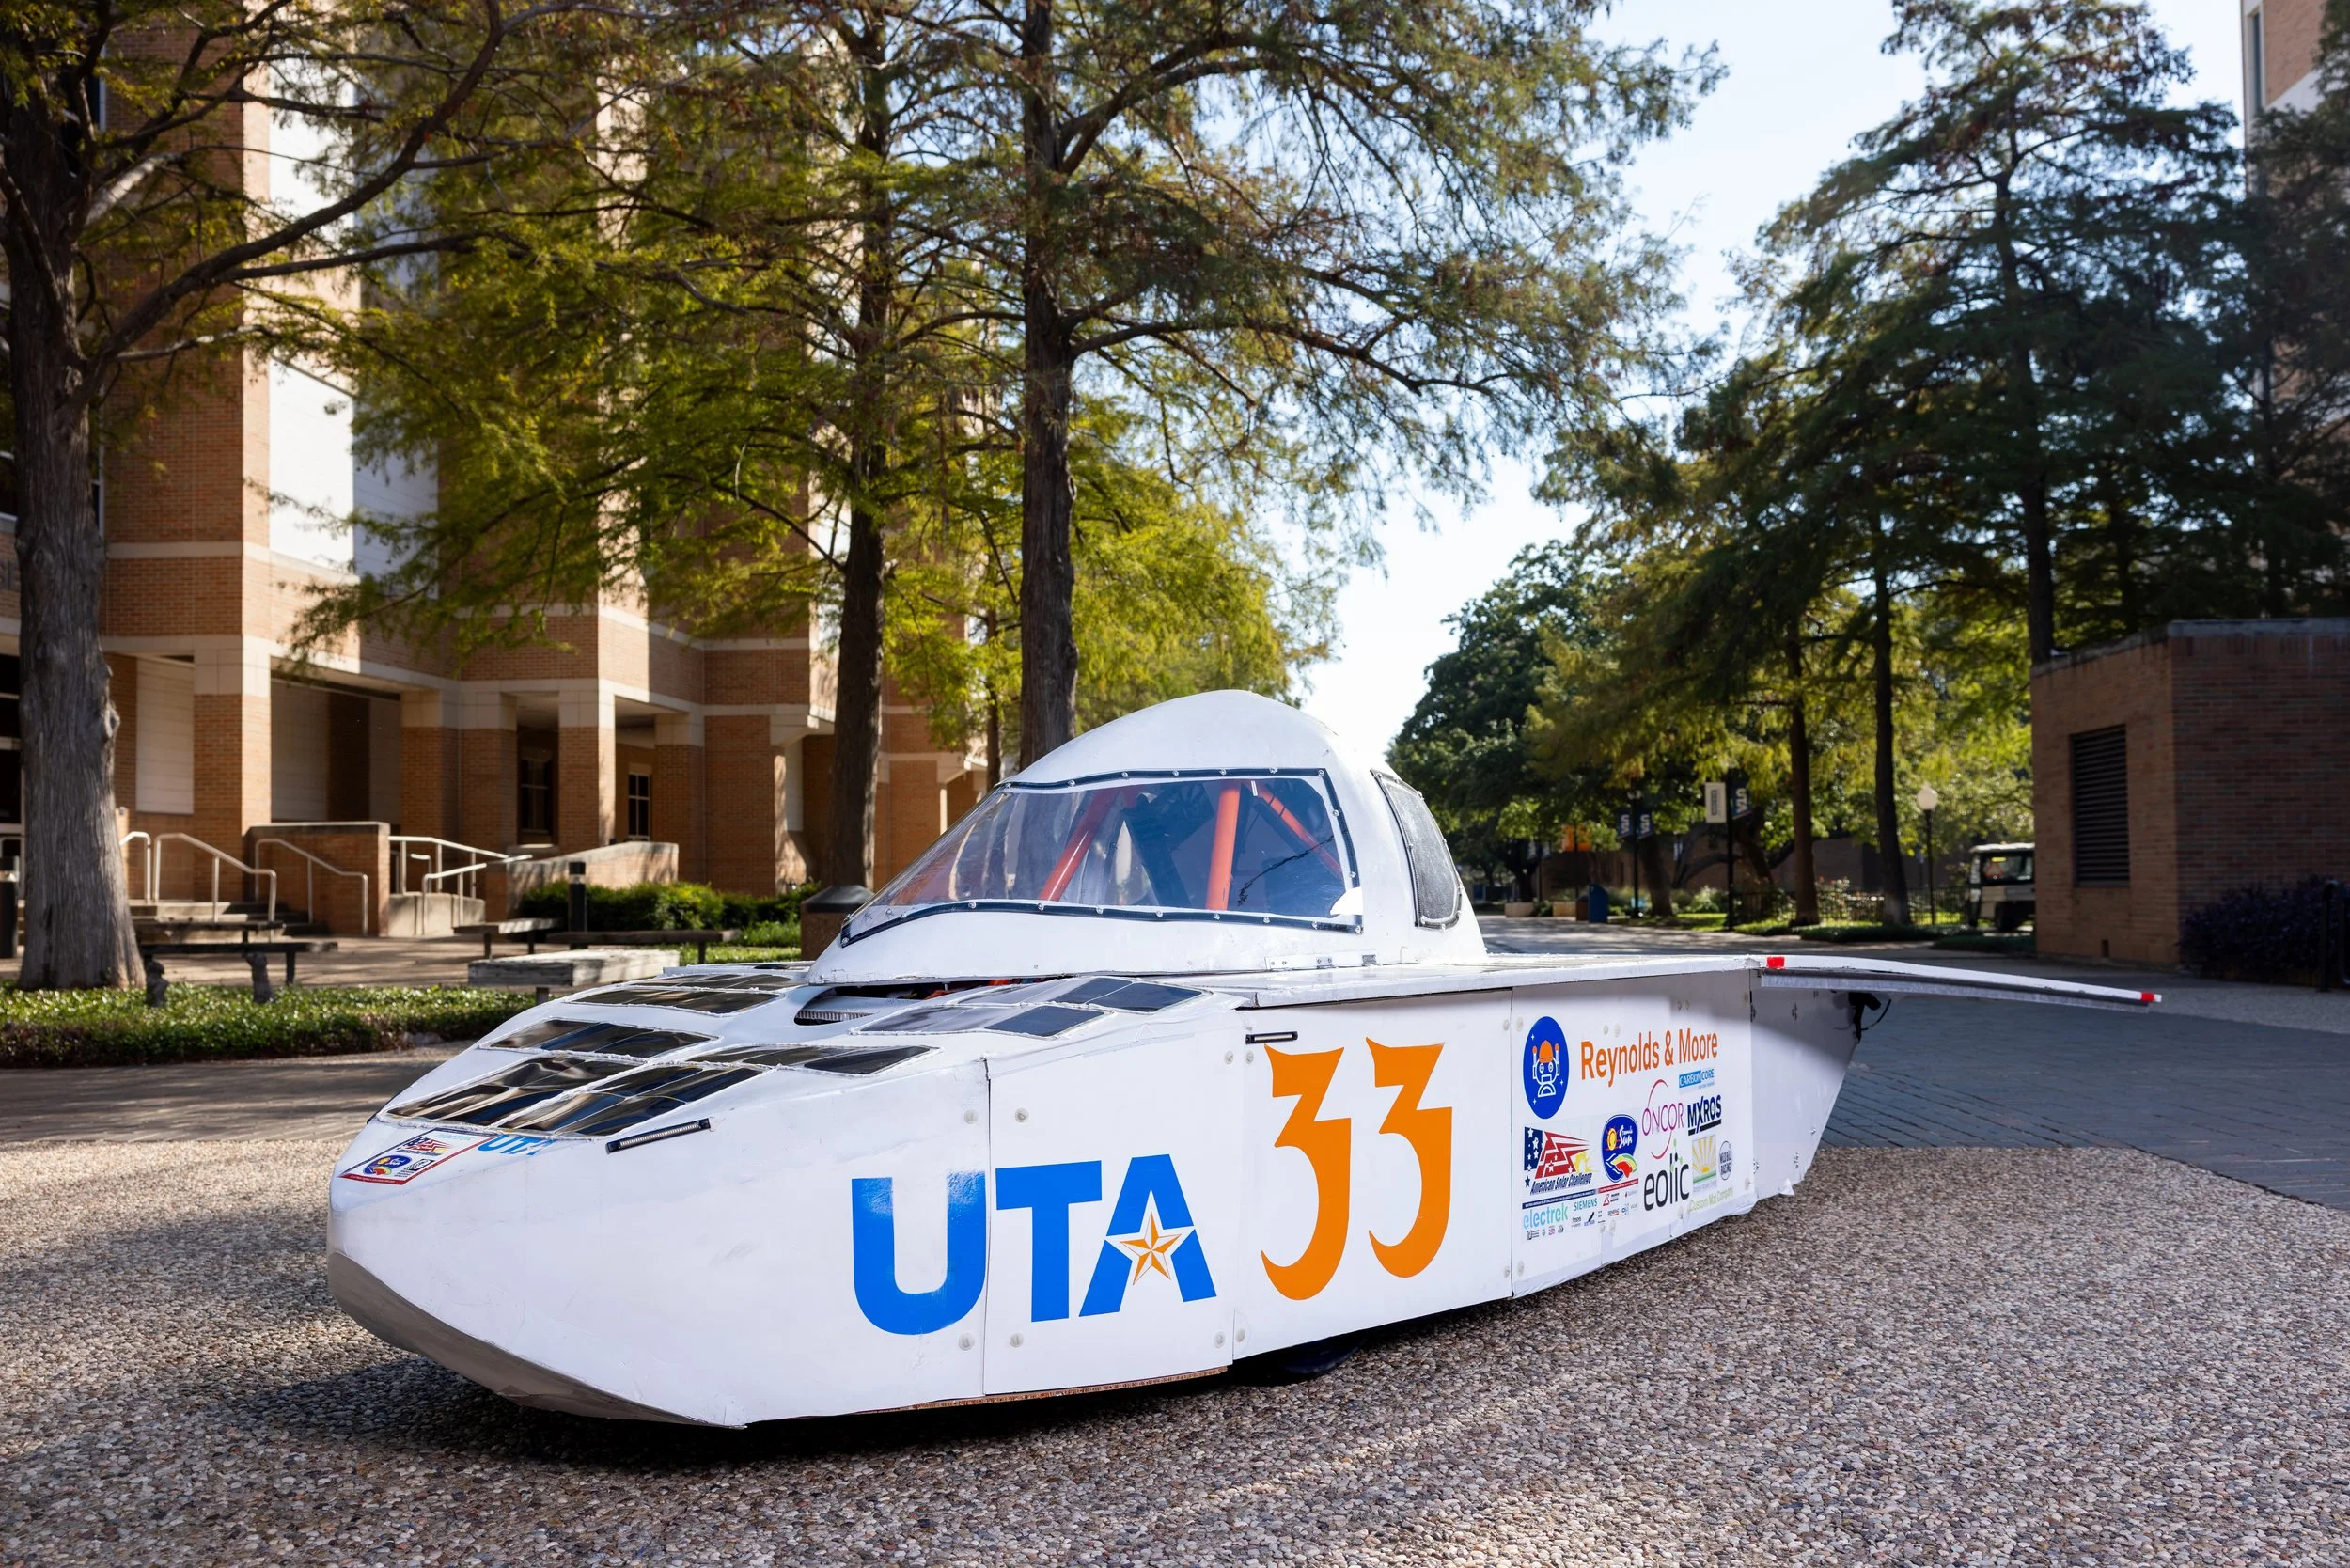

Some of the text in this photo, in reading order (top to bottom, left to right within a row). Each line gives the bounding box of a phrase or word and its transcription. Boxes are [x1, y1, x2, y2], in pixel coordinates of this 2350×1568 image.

[1581, 1028, 1718, 1088] Reynolds & Moore
[1642, 1103, 1684, 1136] ONCOR
[1687, 1095, 1721, 1132] MXROS
[1261, 1037, 1452, 1300] 33
[1530, 1178, 1556, 1195] American
[1555, 1176, 1569, 1189] Solar
[1568, 1172, 1592, 1188] Challenge
[1644, 1152, 1690, 1211] eolic
[1523, 1202, 1569, 1229] electrek
[1574, 1198, 1597, 1211] SIEMENS
[852, 1154, 1217, 1336] UTA
